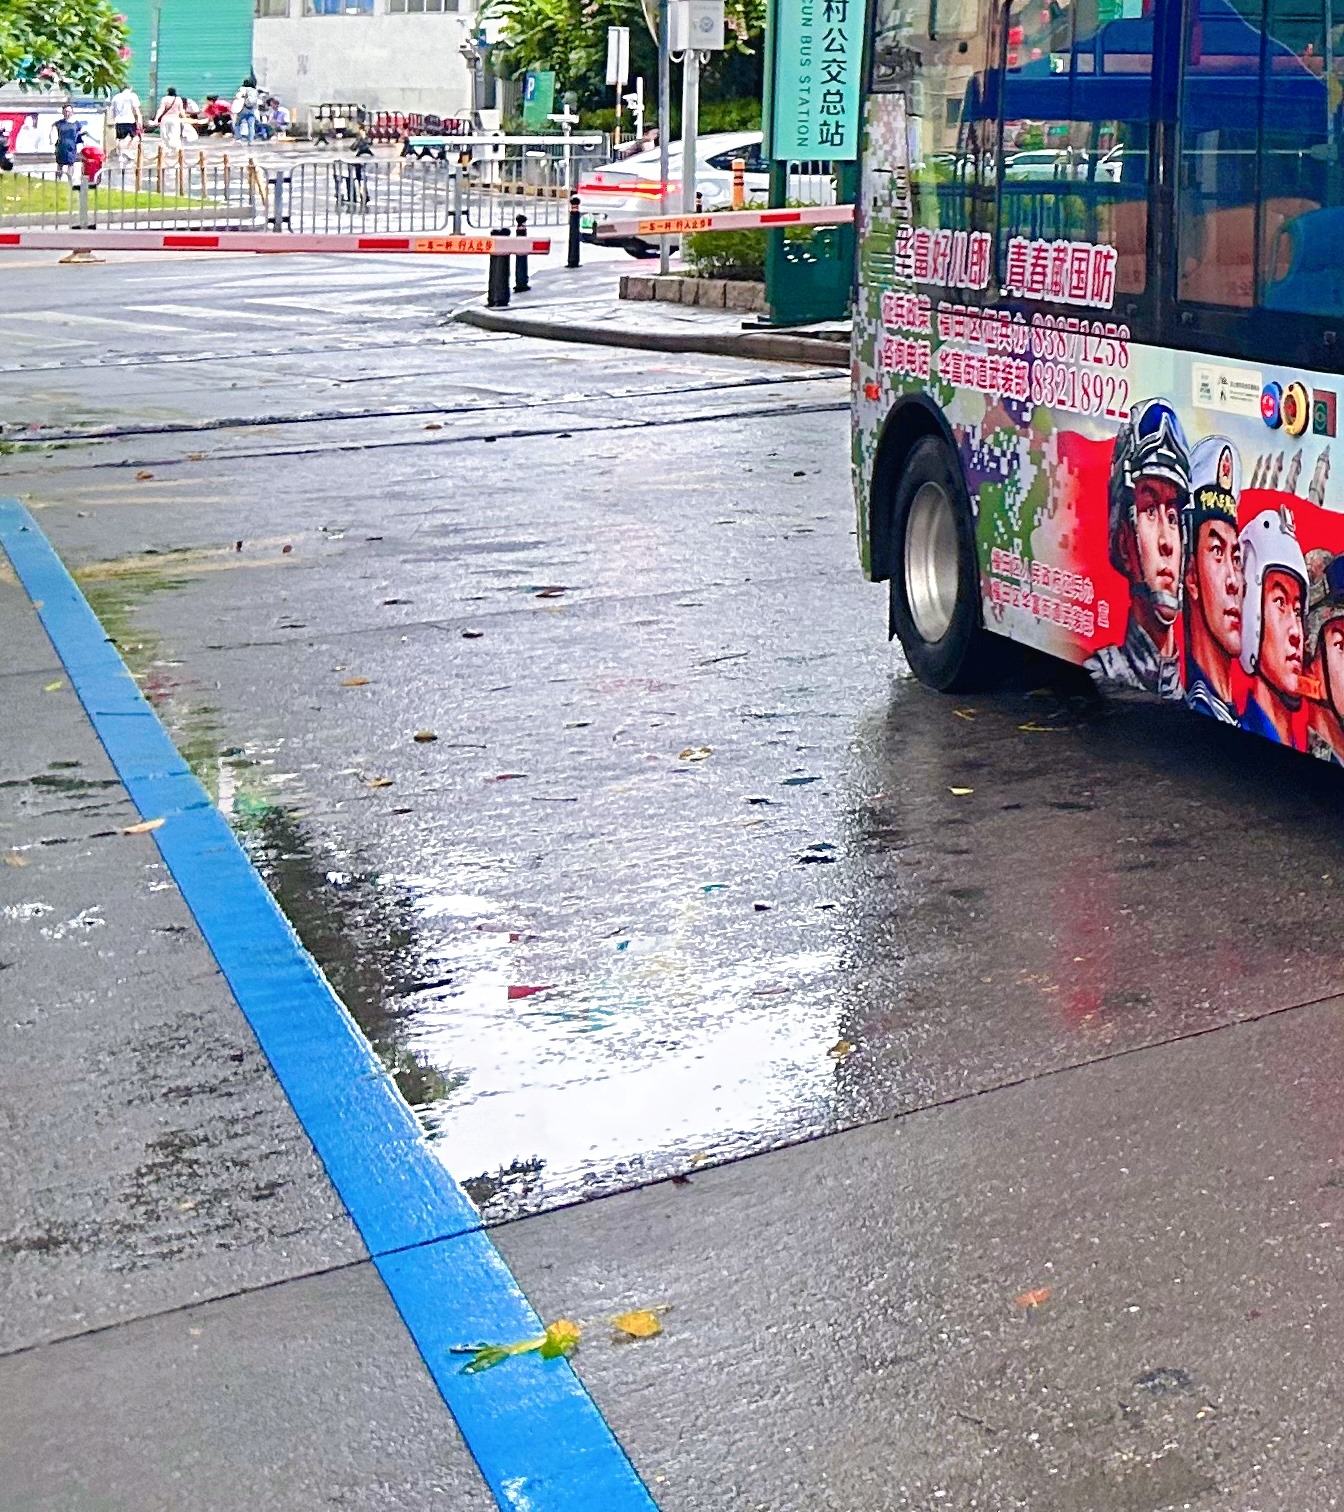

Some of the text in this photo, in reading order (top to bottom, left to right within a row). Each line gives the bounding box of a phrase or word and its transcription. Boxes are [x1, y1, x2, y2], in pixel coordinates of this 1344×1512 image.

[799, 35, 813, 67] BUS
[796, 75, 811, 148] STATION
[1005, 235, 1118, 310] 青春献国防
[1031, 312, 1132, 371] 83871258
[1030, 360, 1131, 424] 83218922
